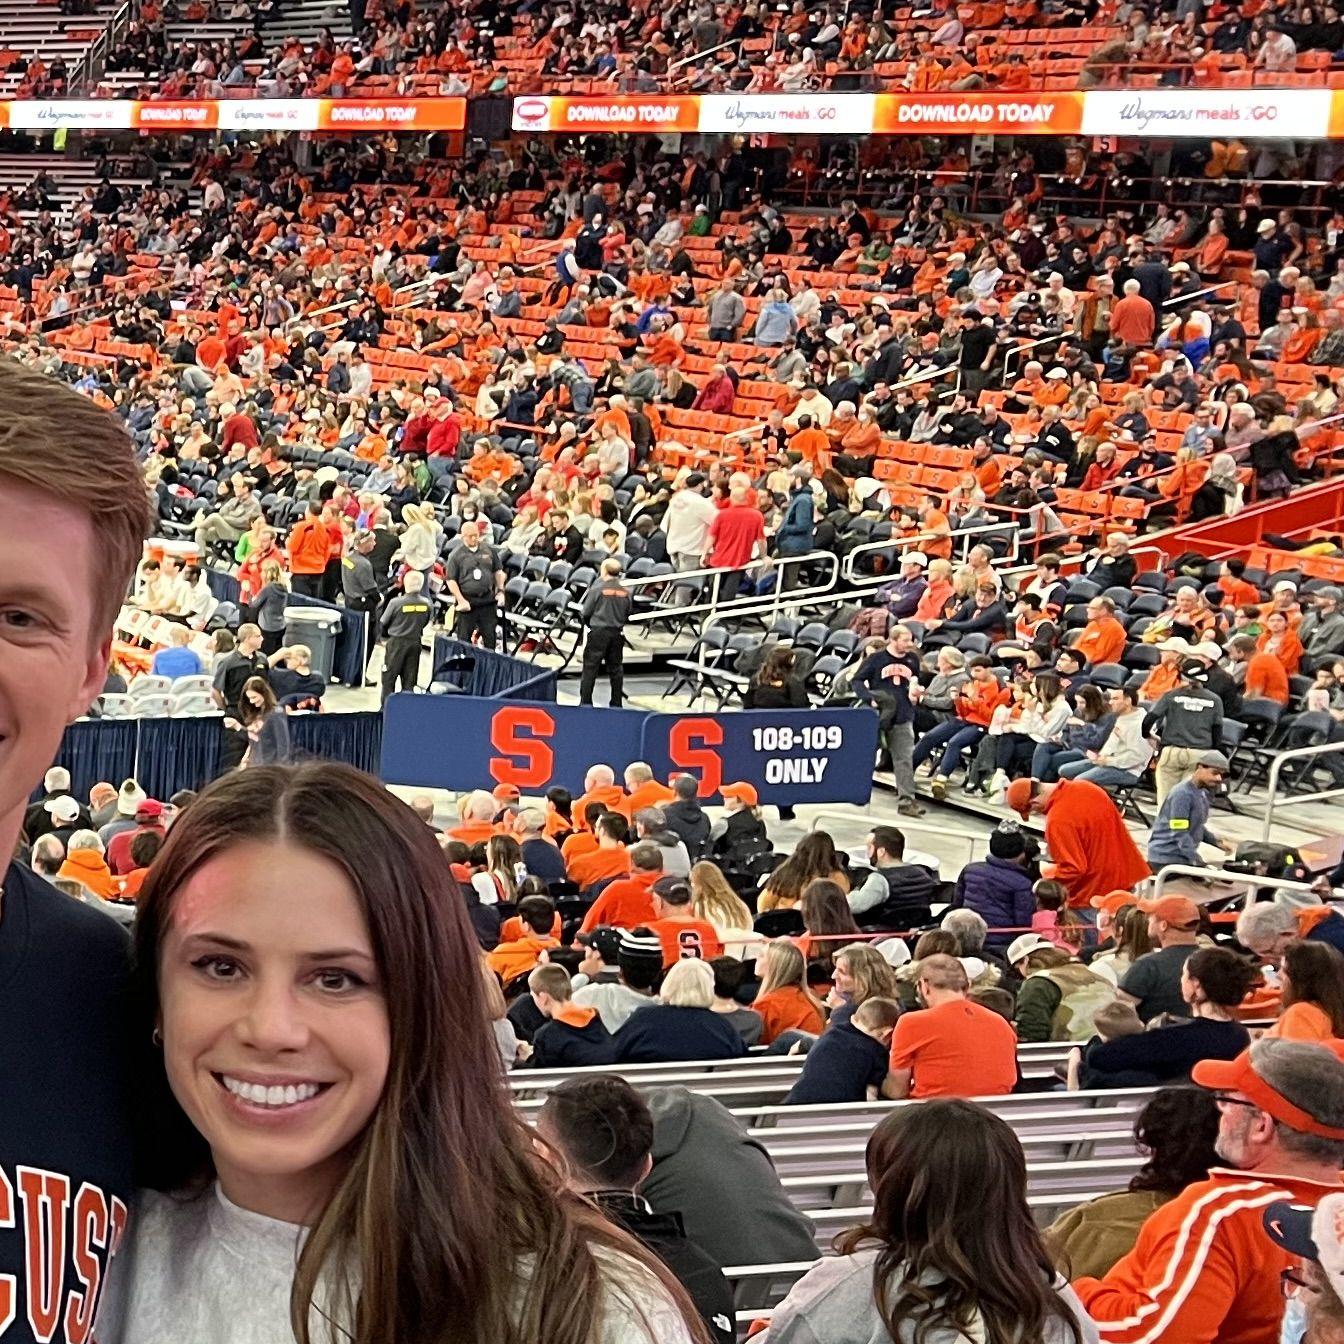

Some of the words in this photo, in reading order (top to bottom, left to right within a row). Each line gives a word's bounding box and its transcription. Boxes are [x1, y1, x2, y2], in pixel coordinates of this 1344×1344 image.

[330, 106, 384, 122] DOWNLOAD
[385, 106, 416, 121] TODAY
[567, 106, 637, 123] DOWNLOAD
[638, 105, 680, 122] TODAY
[898, 103, 994, 123] DOWNLOAD
[996, 102, 1055, 123] TODAY
[1196, 104, 1241, 121] meals
[489, 706, 555, 790] S
[752, 725, 843, 753] 108-109
[668, 717, 723, 798] S
[765, 757, 829, 786] ONLY
